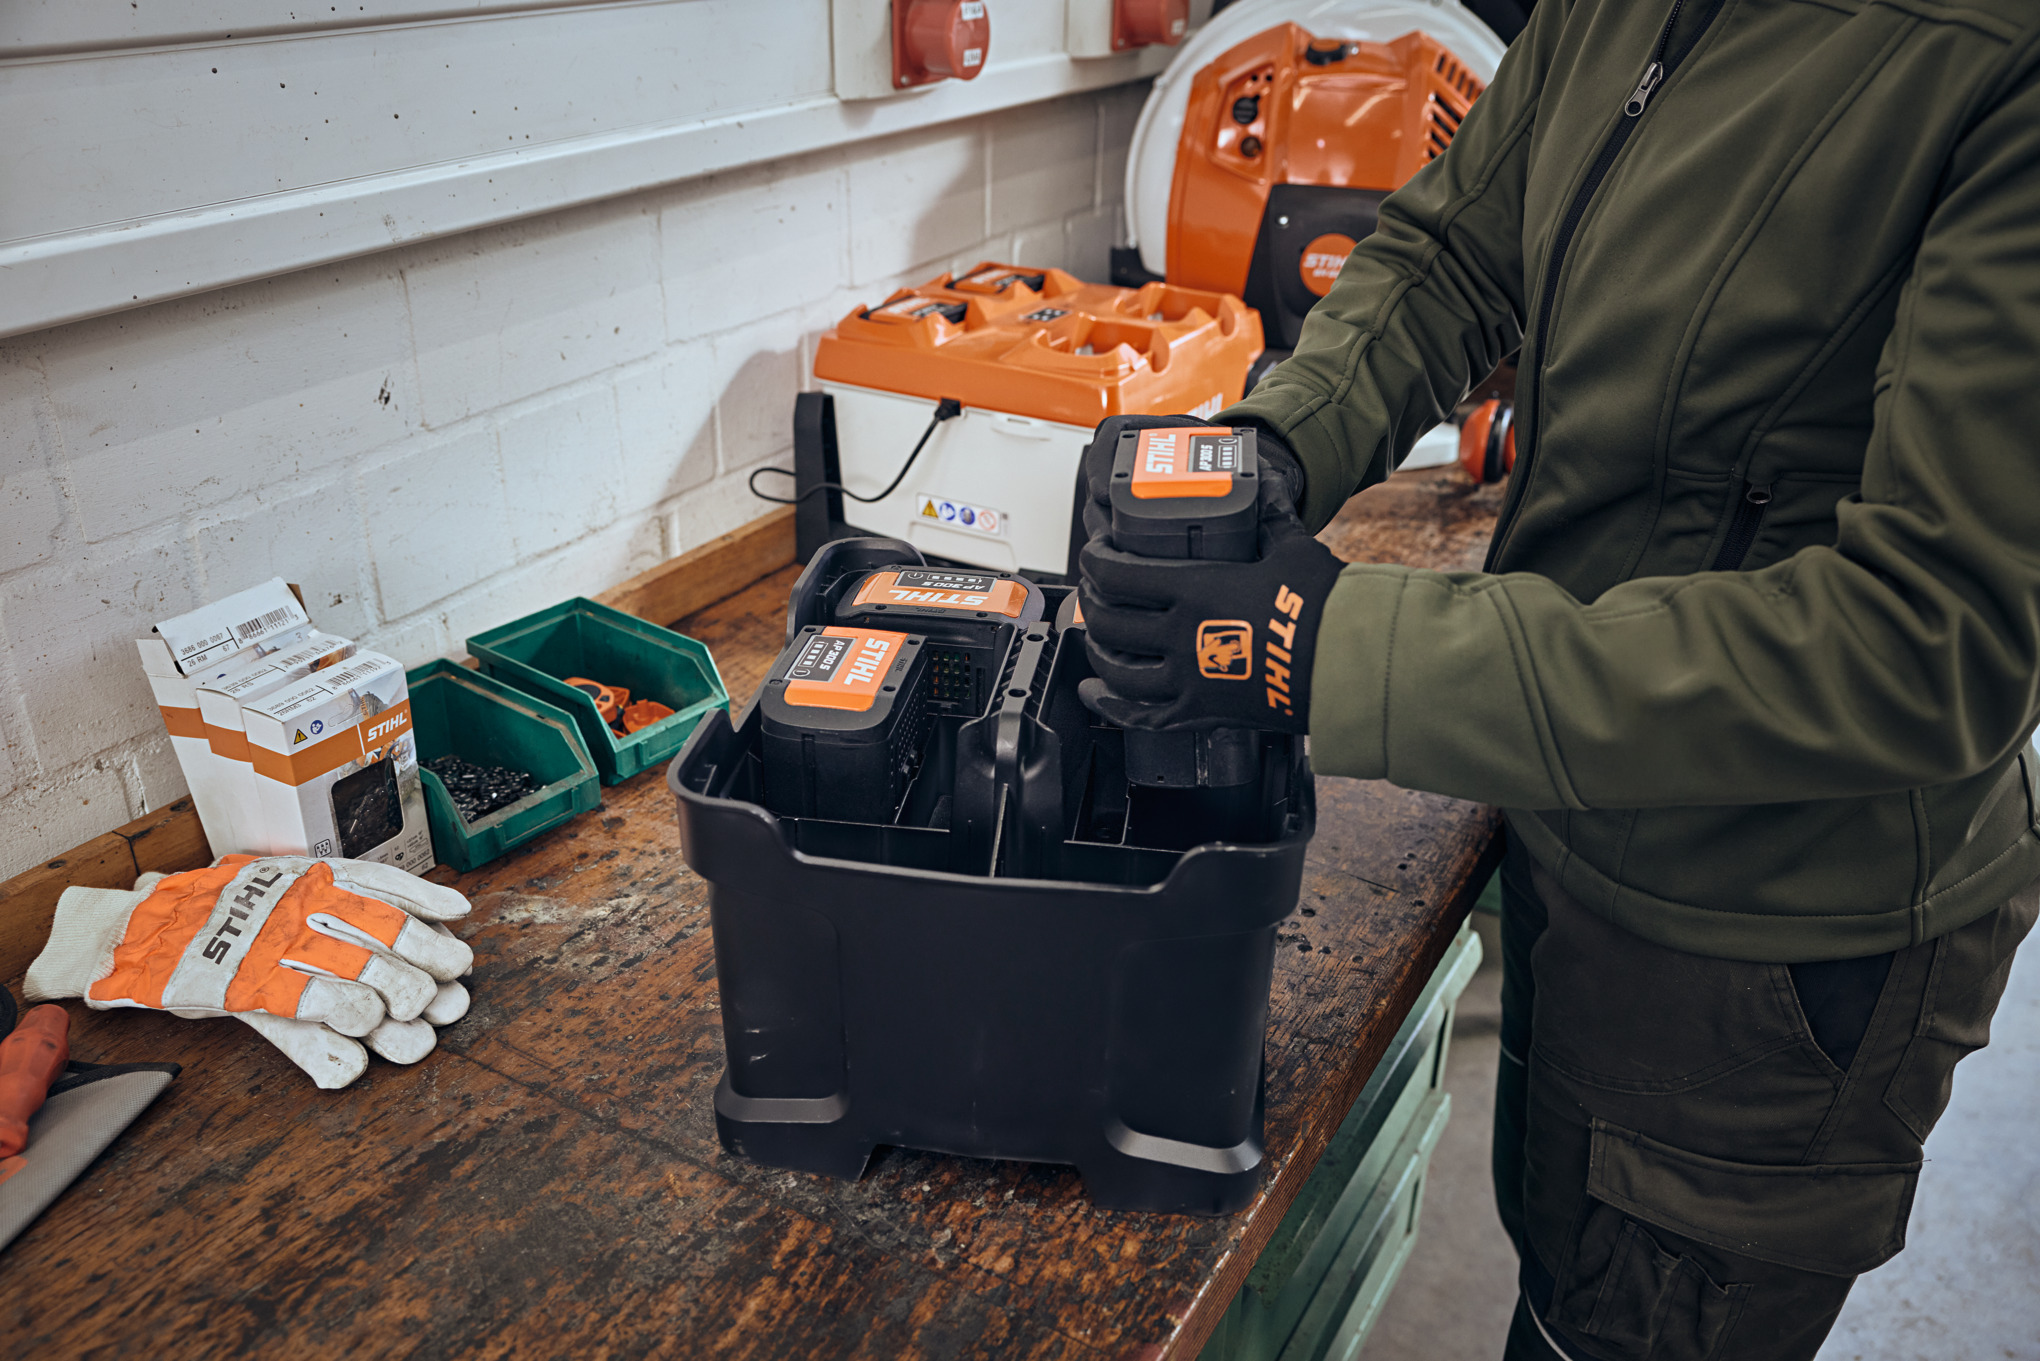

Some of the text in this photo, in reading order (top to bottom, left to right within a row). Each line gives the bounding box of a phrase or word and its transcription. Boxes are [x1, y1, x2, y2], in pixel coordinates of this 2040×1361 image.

[1145, 434, 1176, 474] STIHL
[888, 589, 989, 606] STIHL
[826, 648, 841, 664] 300
[832, 640, 845, 651] AP
[844, 637, 890, 685] STIHL
[1265, 584, 1304, 709] STIHL
[367, 712, 408, 742] STIHL
[202, 872, 283, 965] STIHL
